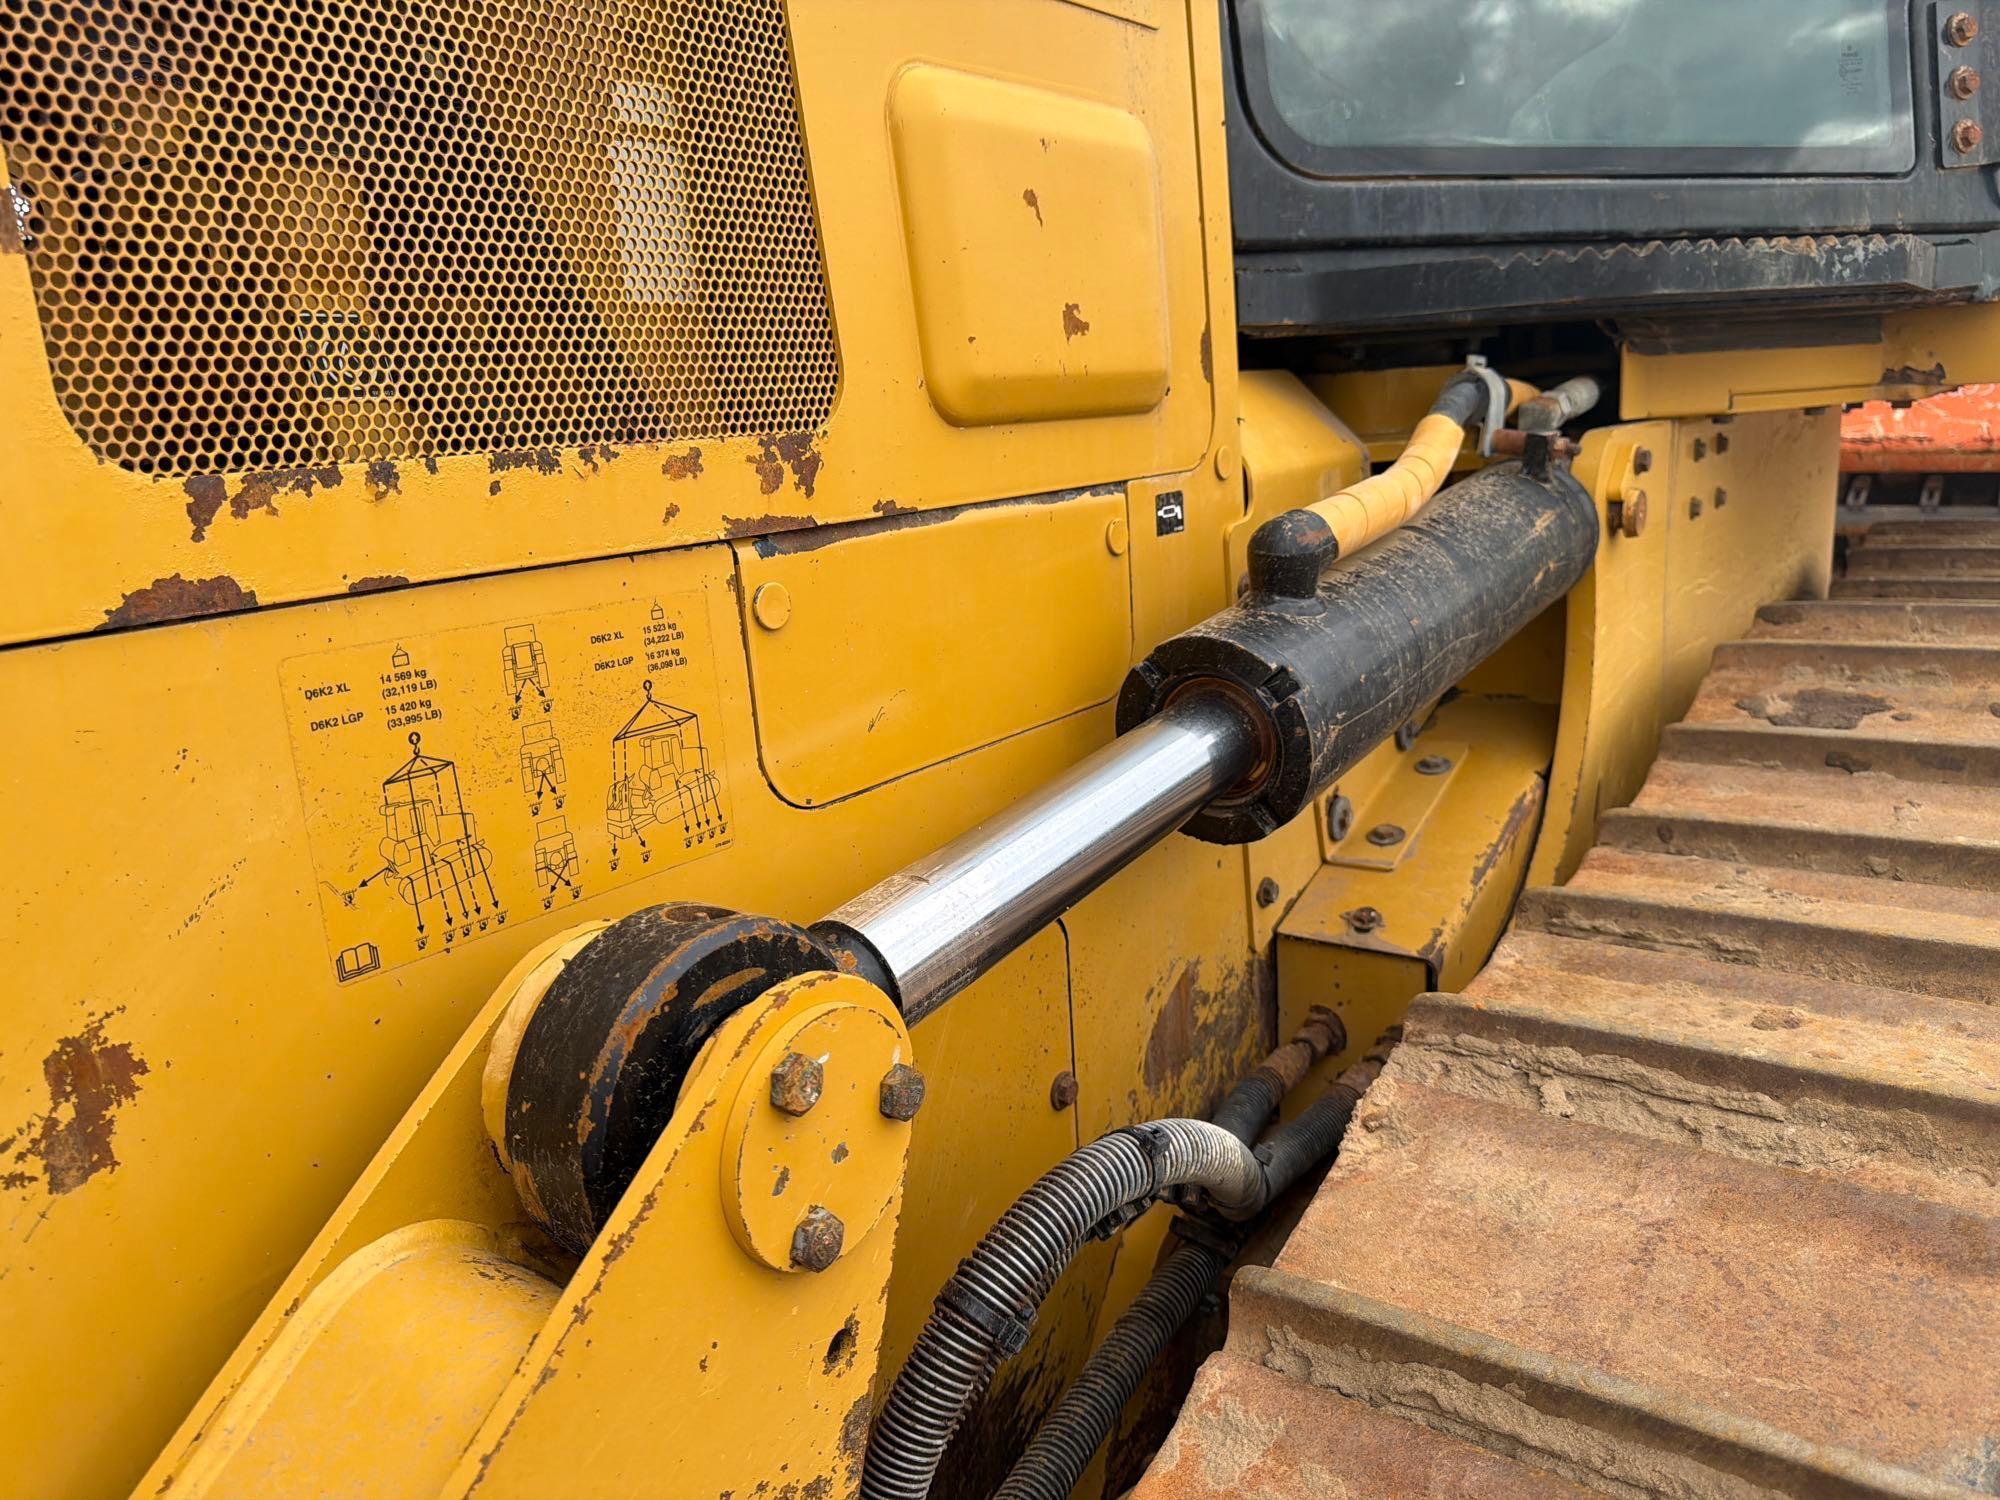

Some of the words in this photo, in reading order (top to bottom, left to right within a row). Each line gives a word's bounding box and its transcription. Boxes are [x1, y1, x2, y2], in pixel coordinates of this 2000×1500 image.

[653, 623, 666, 632] 523
[668, 622, 676, 630] kg
[590, 633, 612, 644] D6K2
[614, 631, 624, 639] XL
[644, 635, 670, 647] (34,222
[672, 631, 684, 640] LB)
[646, 652, 654, 660] 16
[656, 649, 669, 658] 374
[671, 648, 680, 656] kg
[675, 657, 687, 666] LB)
[594, 660, 615, 672] D6K2
[617, 656, 634, 666] LGP
[380, 674, 392, 684] 14
[394, 671, 412, 682] 569
[414, 669, 427, 679] kg
[304, 685, 334, 700] D6K2
[336, 683, 350, 693] XL
[382, 683, 418, 700] (32,119
[420, 679, 437, 690] LB)
[385, 705, 397, 715] 15
[399, 701, 417, 712] 420
[419, 699, 432, 709] kg
[311, 717, 339, 732] D6K2
[342, 712, 364, 724] LGP
[387, 713, 423, 730] (33,995
[425, 709, 442, 721] LB)
